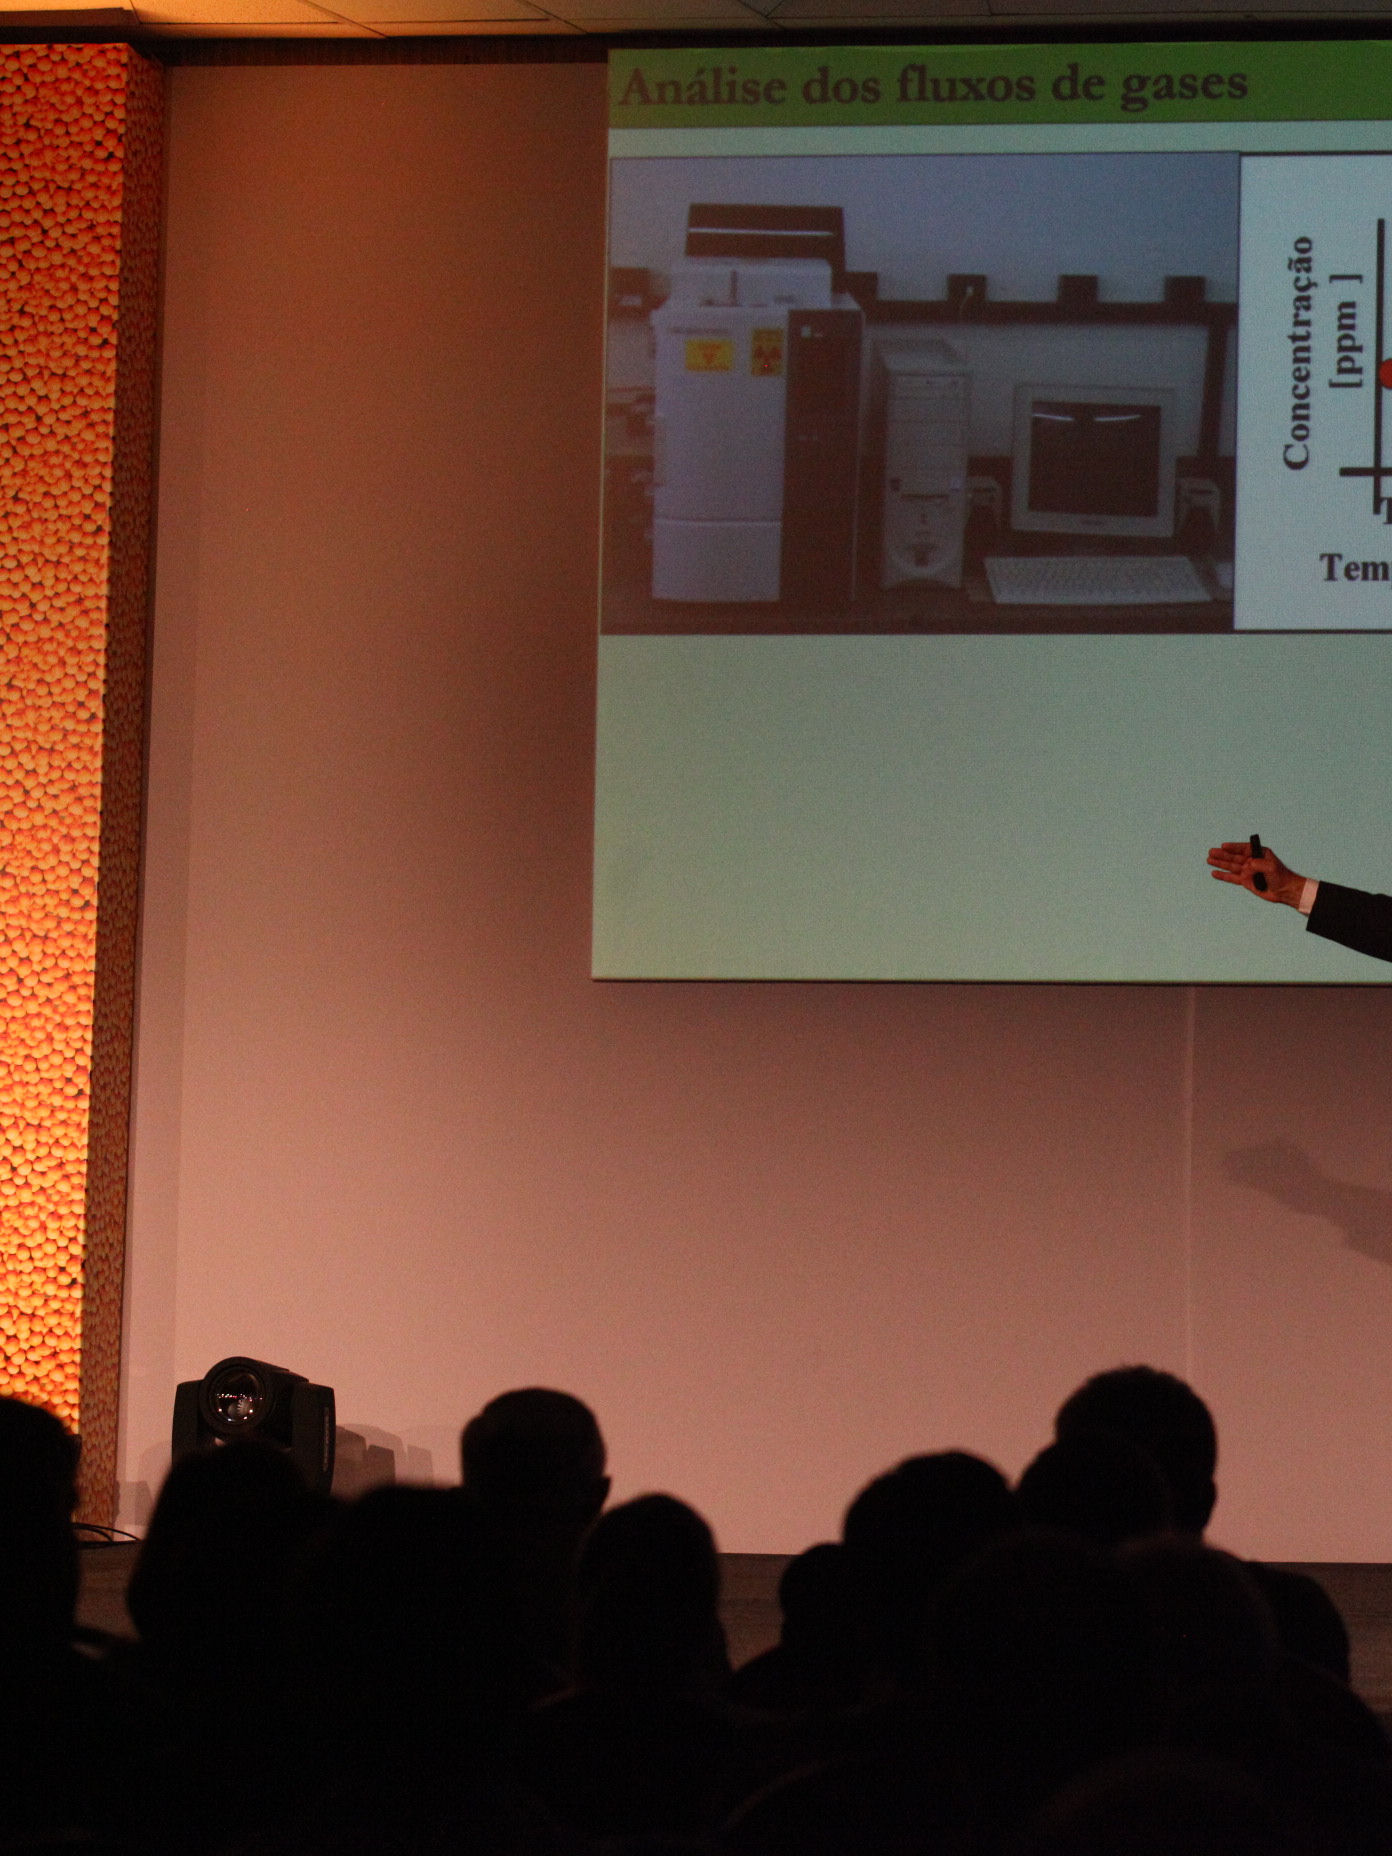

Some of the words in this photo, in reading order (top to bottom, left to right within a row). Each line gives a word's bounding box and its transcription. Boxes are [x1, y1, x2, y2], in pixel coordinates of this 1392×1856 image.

[618, 65, 788, 106] Análise
[801, 65, 882, 105] dos
[897, 63, 1037, 103] fluxos
[1051, 62, 1106, 102] de
[1119, 73, 1249, 113] gases
[1283, 236, 1318, 471] Concentração
